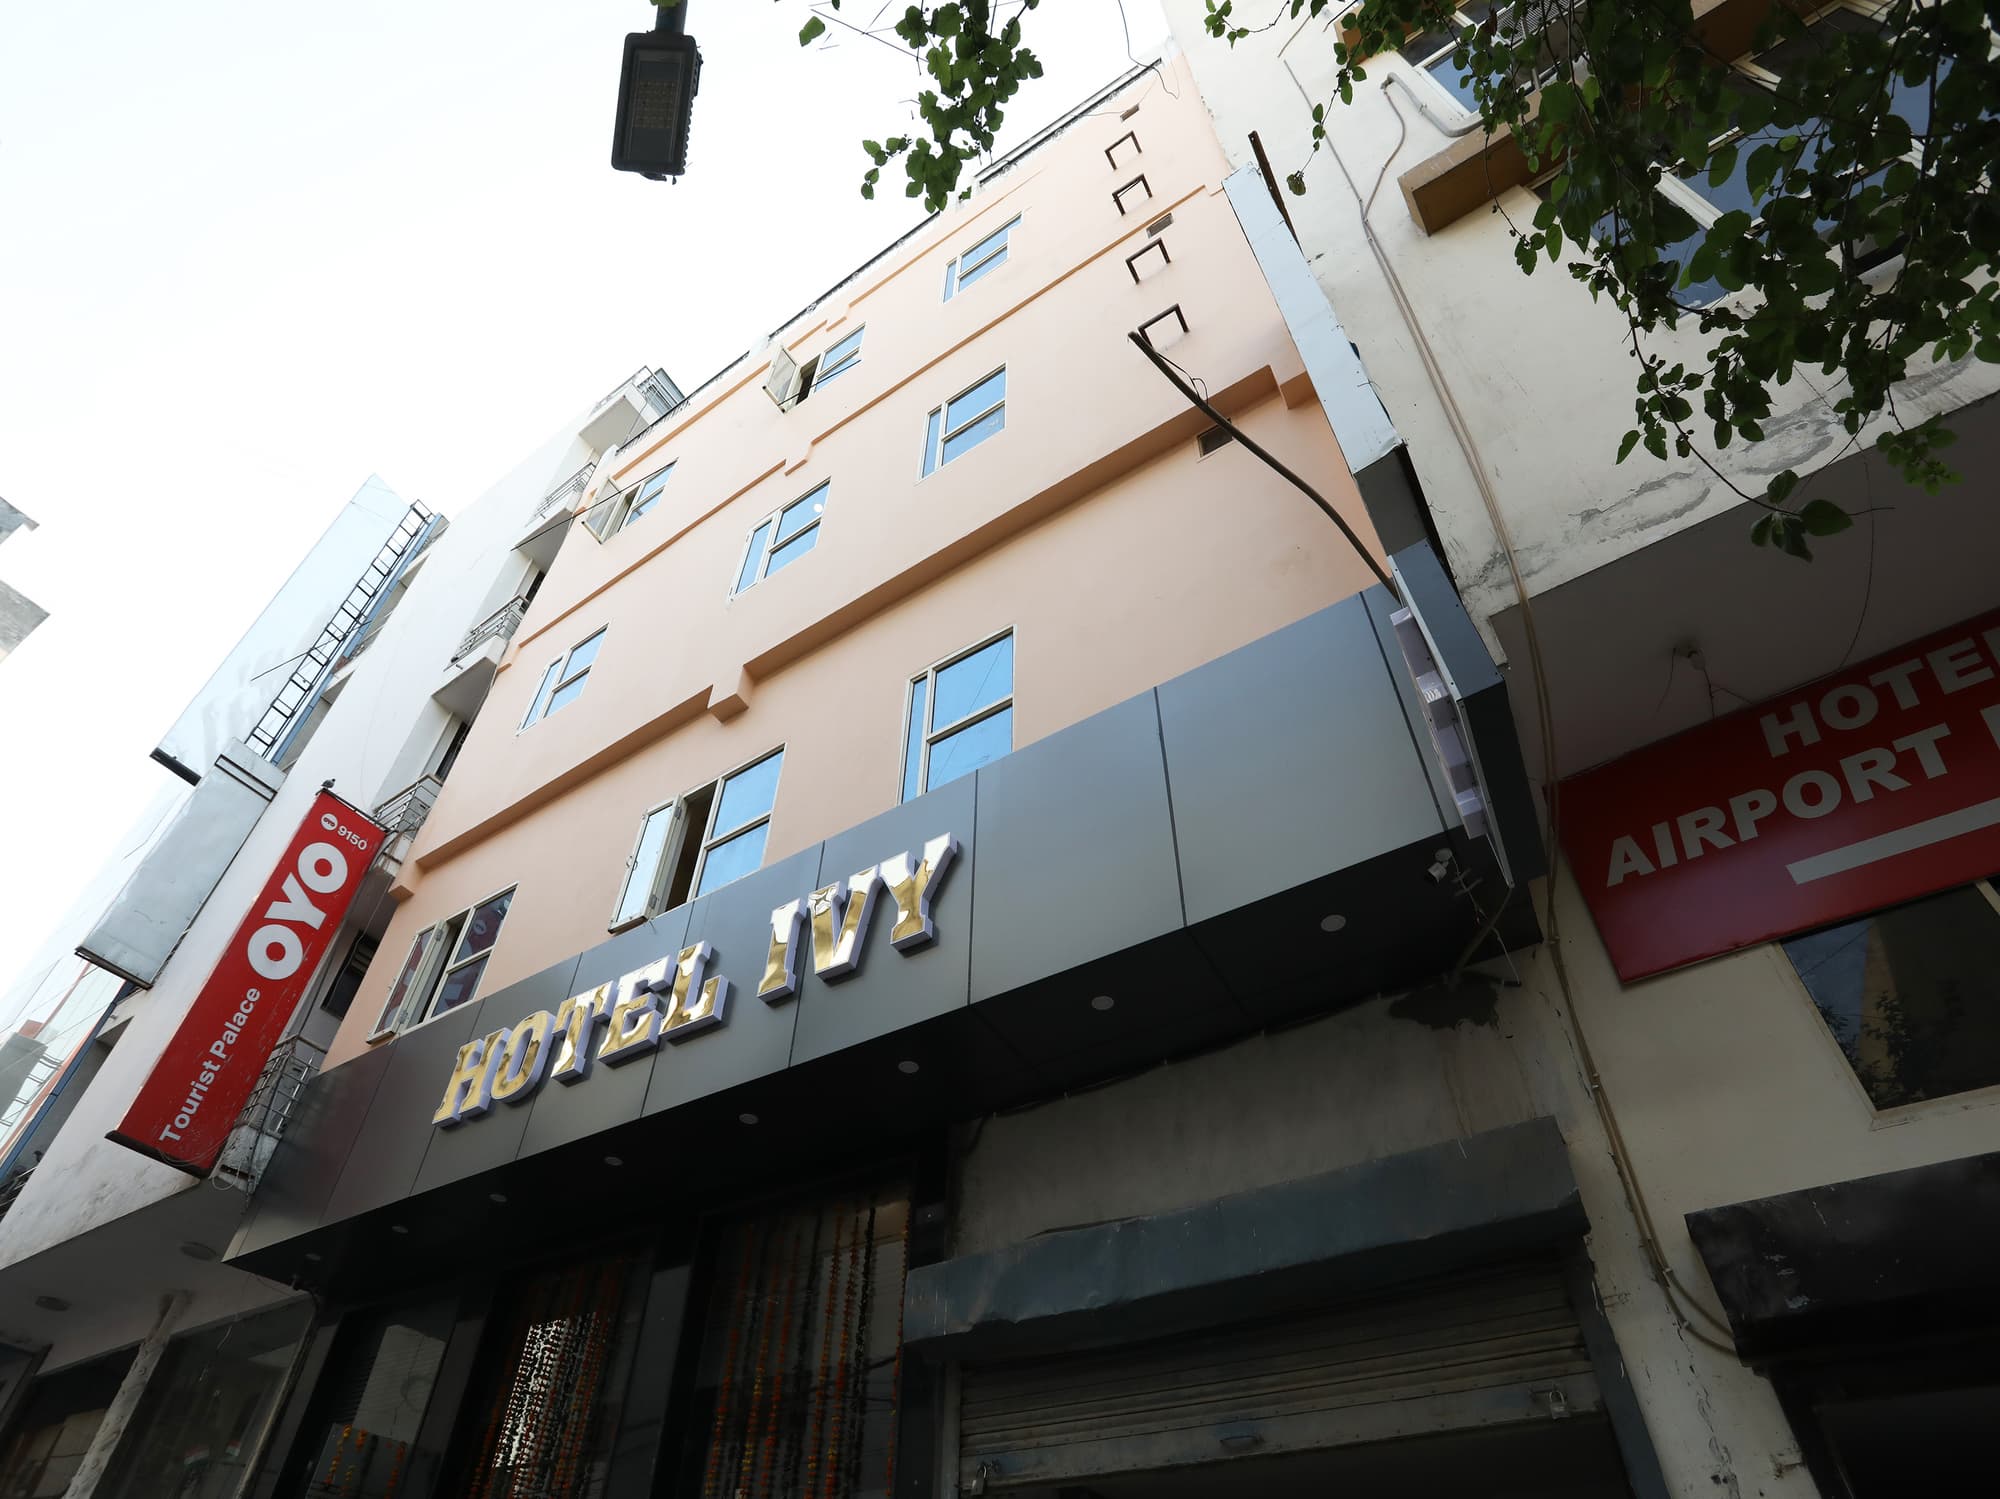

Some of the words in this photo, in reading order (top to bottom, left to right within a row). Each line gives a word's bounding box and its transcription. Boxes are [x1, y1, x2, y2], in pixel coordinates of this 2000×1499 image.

[337, 825, 368, 851] 9150
[1606, 723, 1951, 888] AIRPORT
[159, 1061, 219, 1143] Tourist
[210, 987, 261, 1060] Palace
[247, 842, 348, 980] OYO
[432, 941, 729, 1127] HOTEL
[757, 832, 958, 1003] IVY
